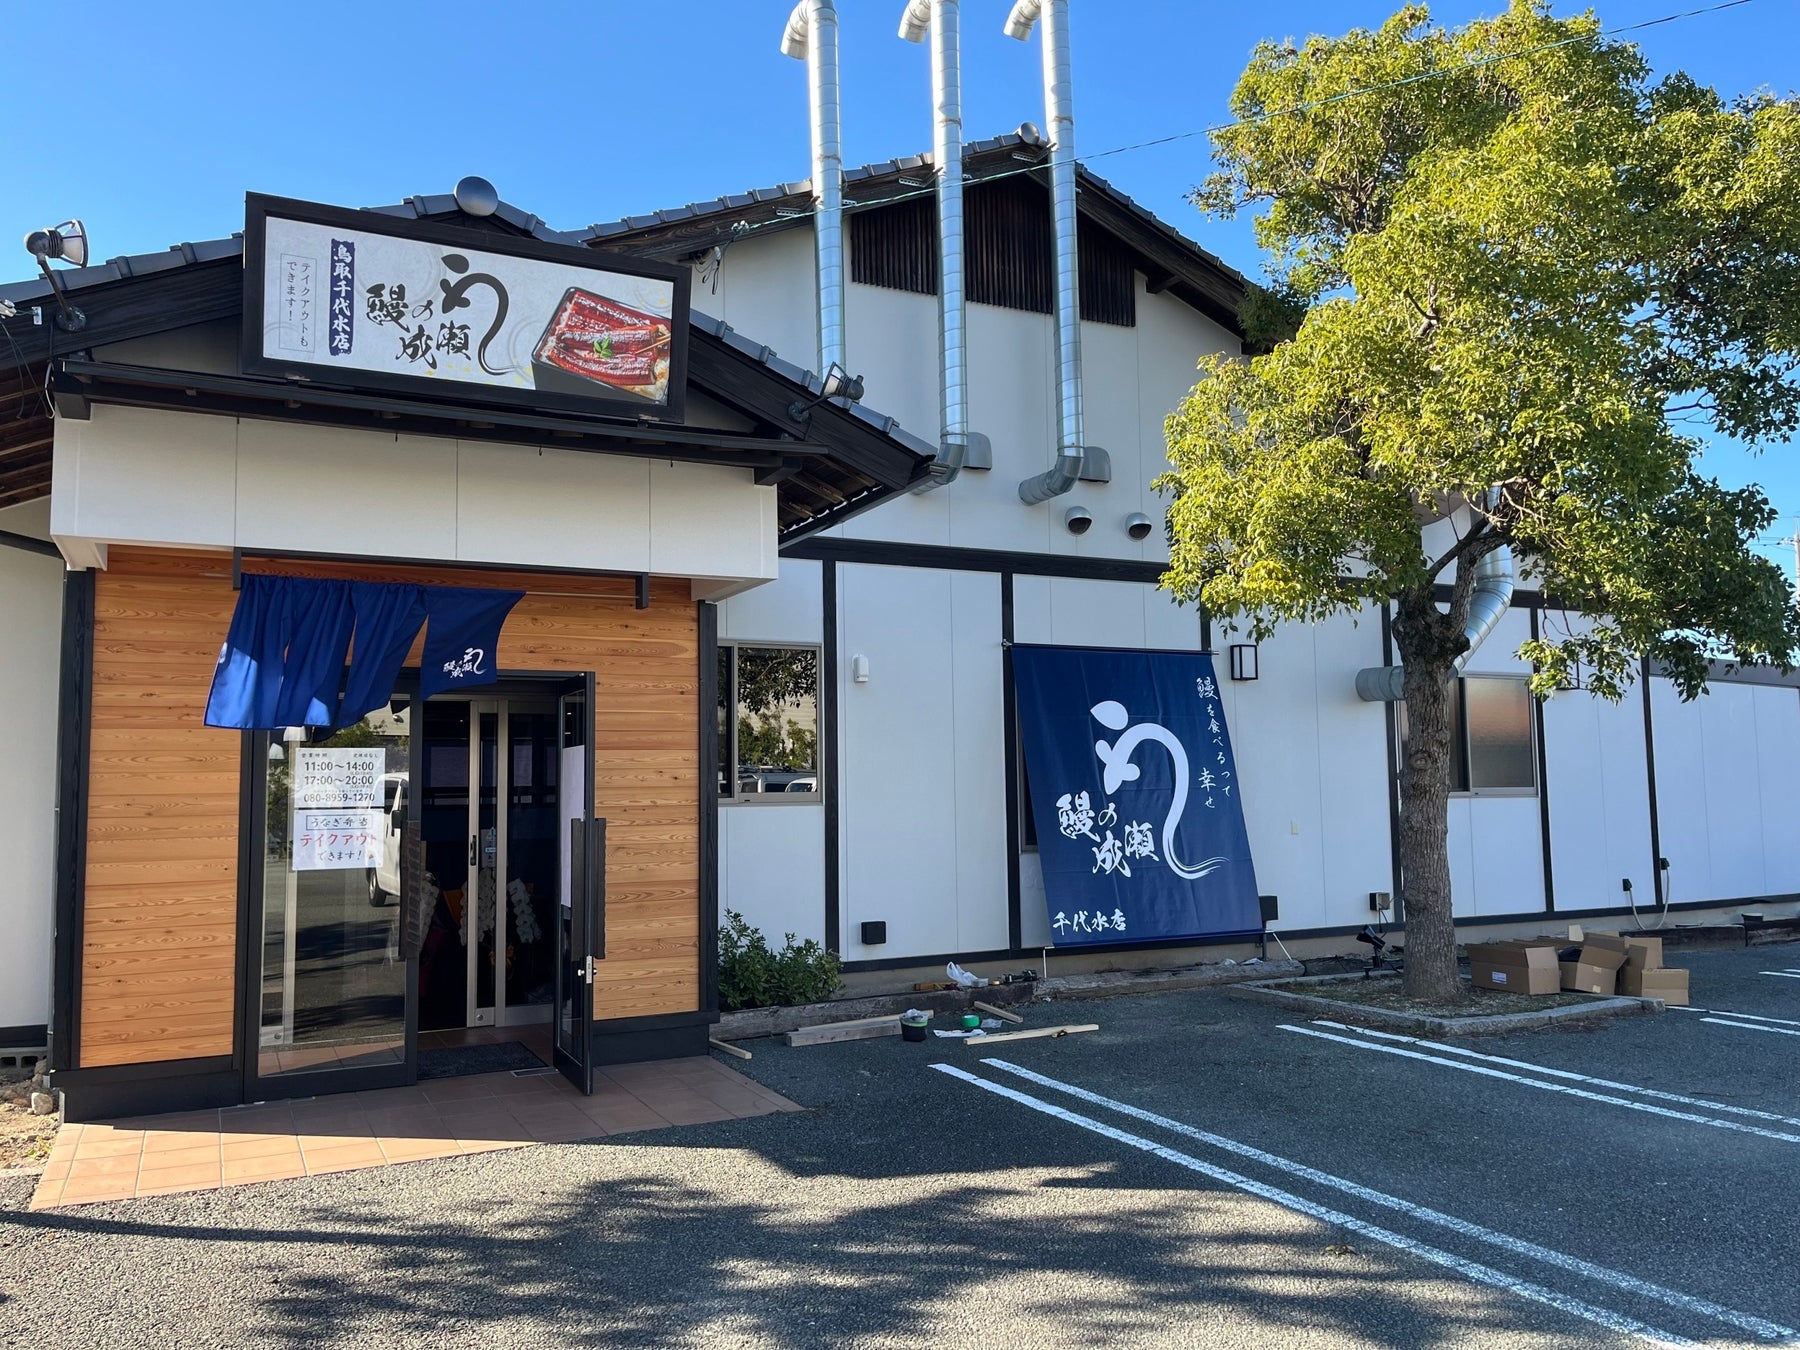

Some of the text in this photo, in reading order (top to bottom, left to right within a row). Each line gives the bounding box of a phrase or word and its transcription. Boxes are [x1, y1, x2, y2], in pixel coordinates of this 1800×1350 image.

[284, 261, 298, 321] できます！
[300, 262, 311, 347] テイクアウトも
[331, 243, 353, 350] 鳥取千代水店
[1196, 676, 1231, 798] 鰻を食べるって
[303, 792, 375, 802] 080-8959-1270
[1198, 767, 1216, 809] 幸せ
[300, 832, 377, 848] テイクアウト
[1052, 908, 1127, 936] 千代水店
